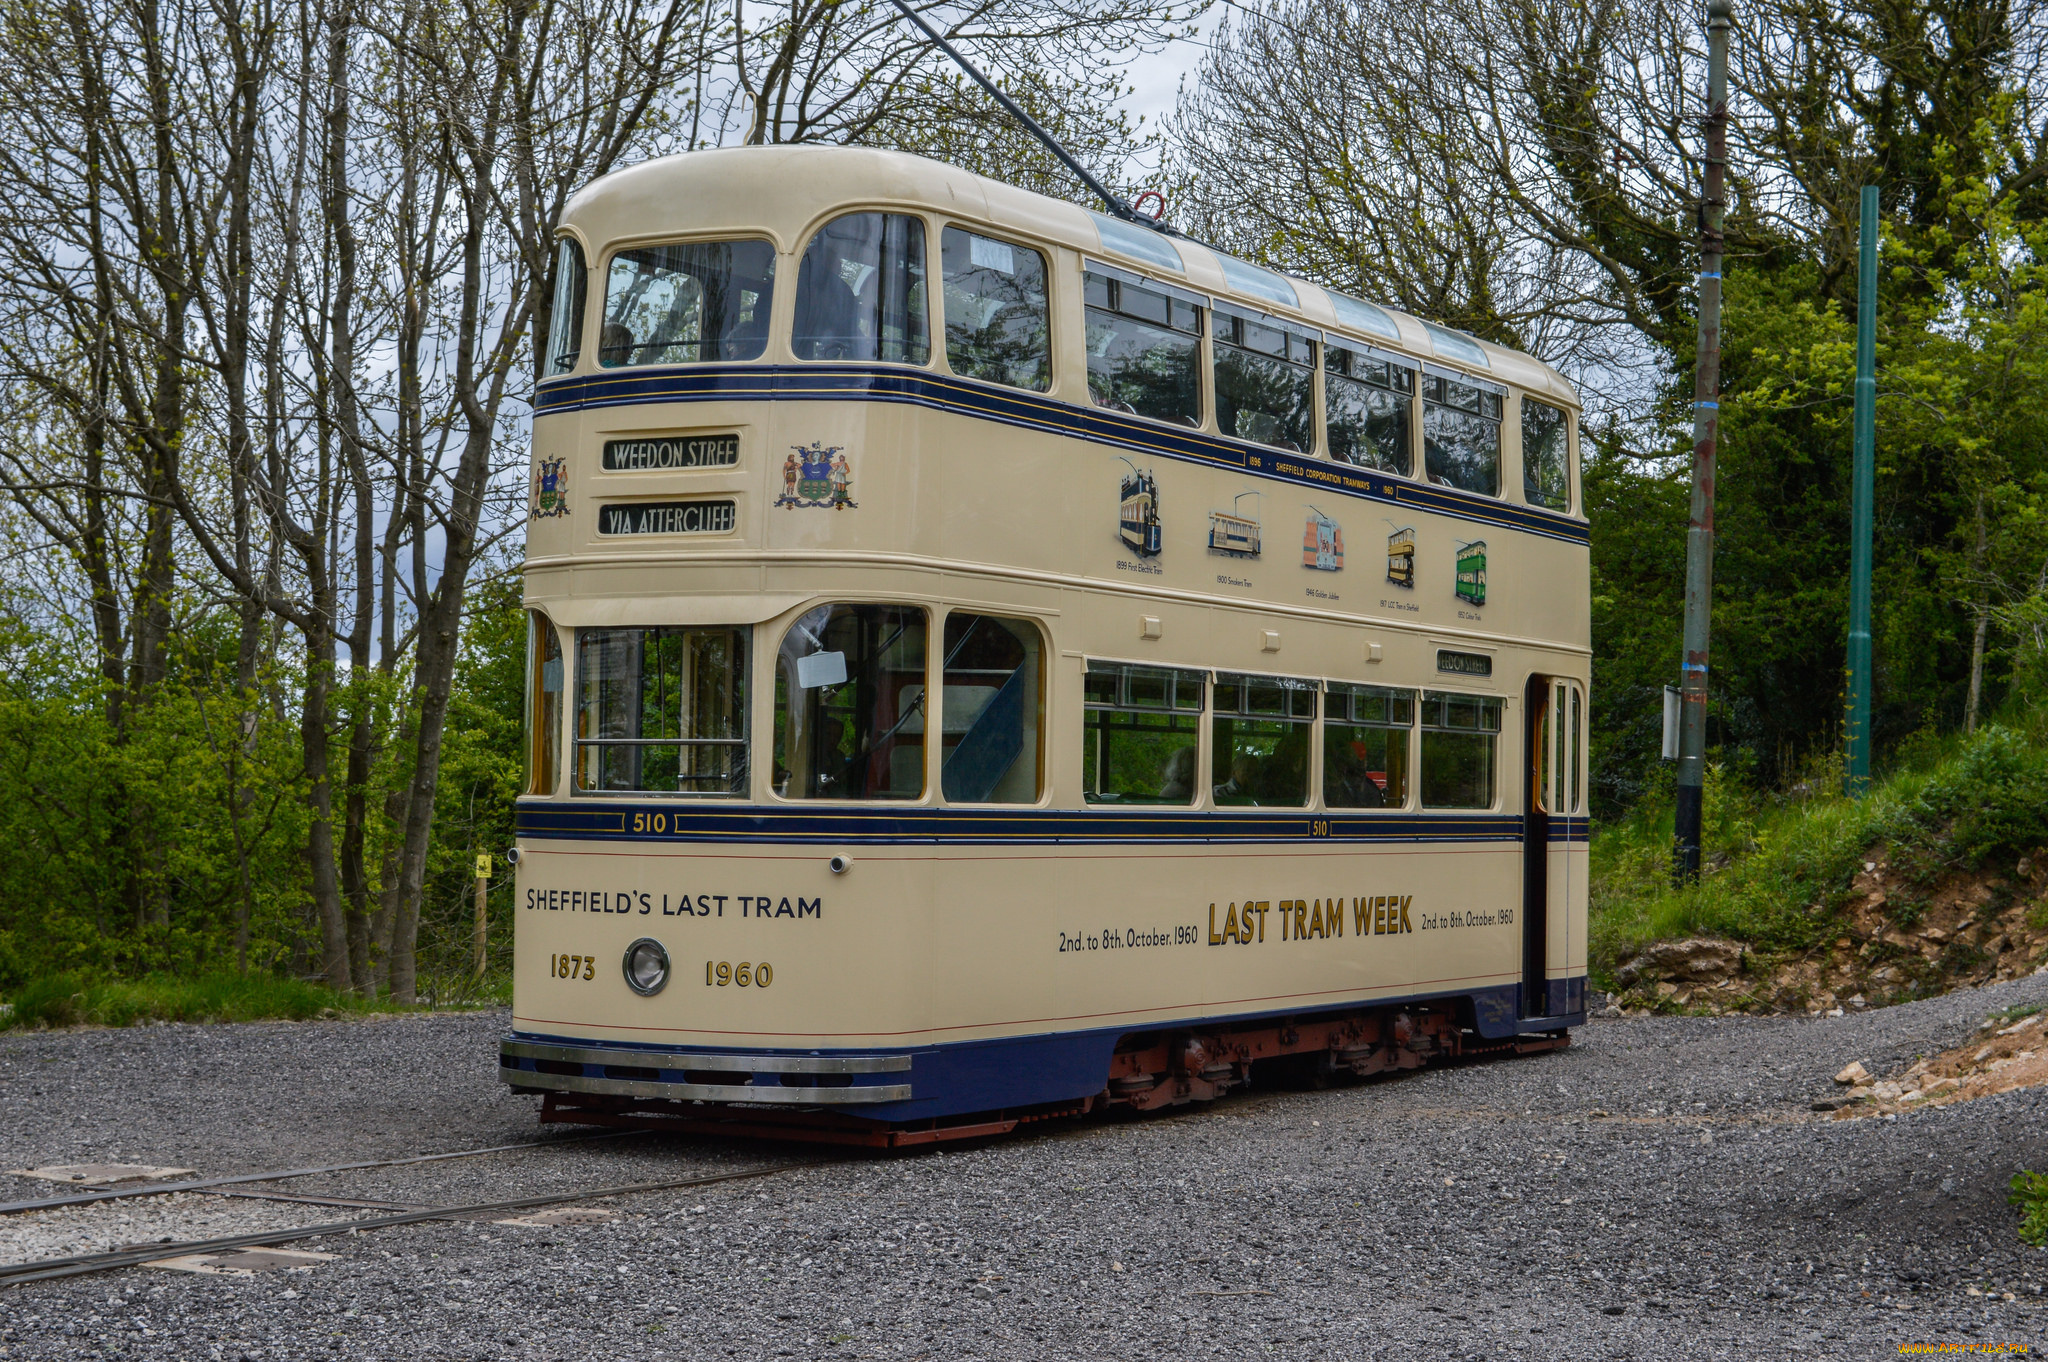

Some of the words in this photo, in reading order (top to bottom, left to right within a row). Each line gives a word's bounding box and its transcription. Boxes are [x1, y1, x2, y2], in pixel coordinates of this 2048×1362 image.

[613, 441, 683, 469] WEEDON
[1249, 456, 1262, 467] 1896
[1275, 461, 1304, 477] SHEFFIELD
[1305, 468, 1342, 485] CORPORATION
[1342, 476, 1370, 490] TRAMWAYS
[1383, 485, 1394, 496] 1960
[609, 510, 632, 534] VIA
[1138, 563, 1153, 574] Electric
[633, 812, 667, 834] 510
[1312, 820, 1328, 837] 510
[526, 888, 651, 916] SHEFFIELD'S
[662, 894, 729, 918] LAST
[737, 896, 821, 919] TRAM
[1208, 900, 1270, 946] LAST
[1278, 897, 1344, 942] TRAM
[1353, 895, 1413, 937] WEEK
[1421, 912, 1439, 930] 2nd.
[1439, 915, 1448, 929] to
[1497, 908, 1514, 925] 1960
[1058, 930, 1085, 953] 2nd.
[1086, 935, 1099, 951] to
[1102, 928, 1125, 950] 8th.
[1174, 925, 1198, 945] 1960
[551, 953, 596, 982] 1873
[704, 960, 774, 989] 1960
